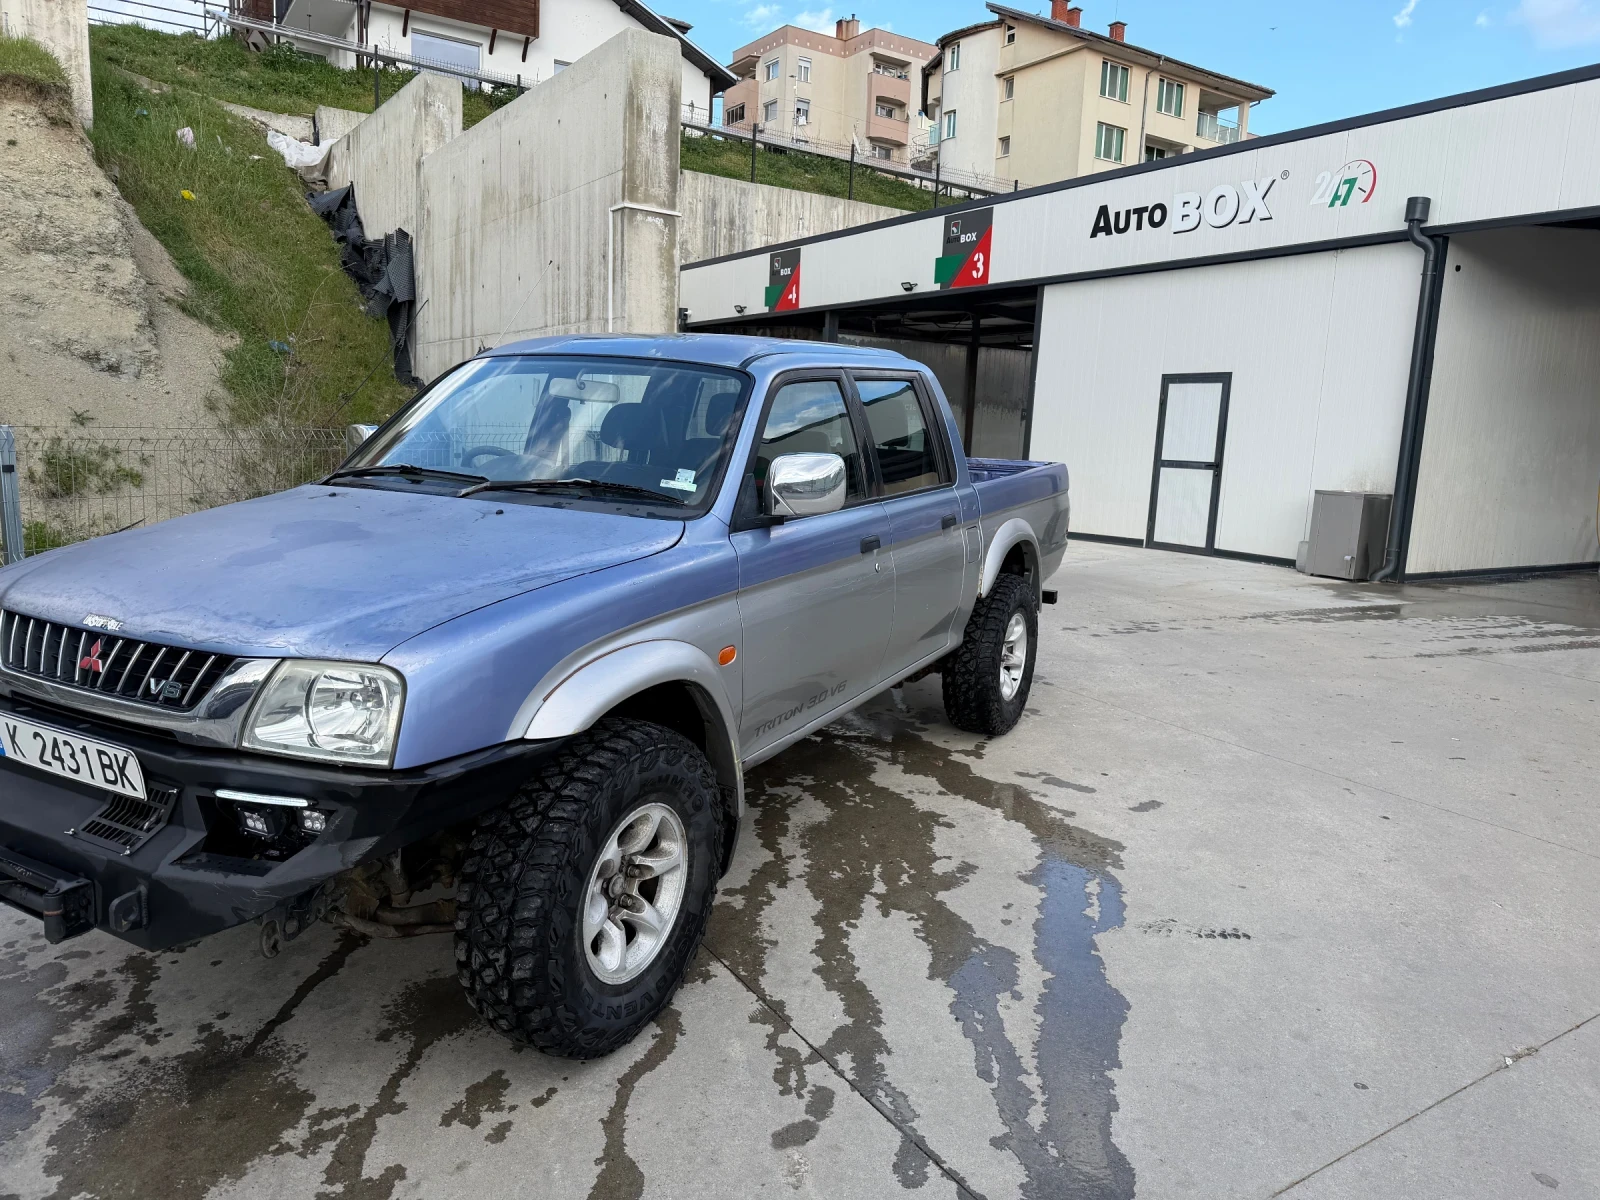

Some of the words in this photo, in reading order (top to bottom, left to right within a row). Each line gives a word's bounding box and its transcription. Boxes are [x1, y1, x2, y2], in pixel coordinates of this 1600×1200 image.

[1090, 202, 1167, 239] AUTO
[1171, 176, 1276, 234] BOX
[960, 231, 978, 244] BOX
[780, 267, 792, 277] BOX
[971, 252, 985, 279] 3
[787, 283, 798, 305] 4
[150, 678, 182, 698] V6
[754, 703, 804, 737] TRITON
[806, 690, 829, 709] 3.0
[830, 680, 848, 697] V6
[5, 722, 26, 758] K
[32, 731, 95, 780] 2431
[97, 749, 138, 792] BK
